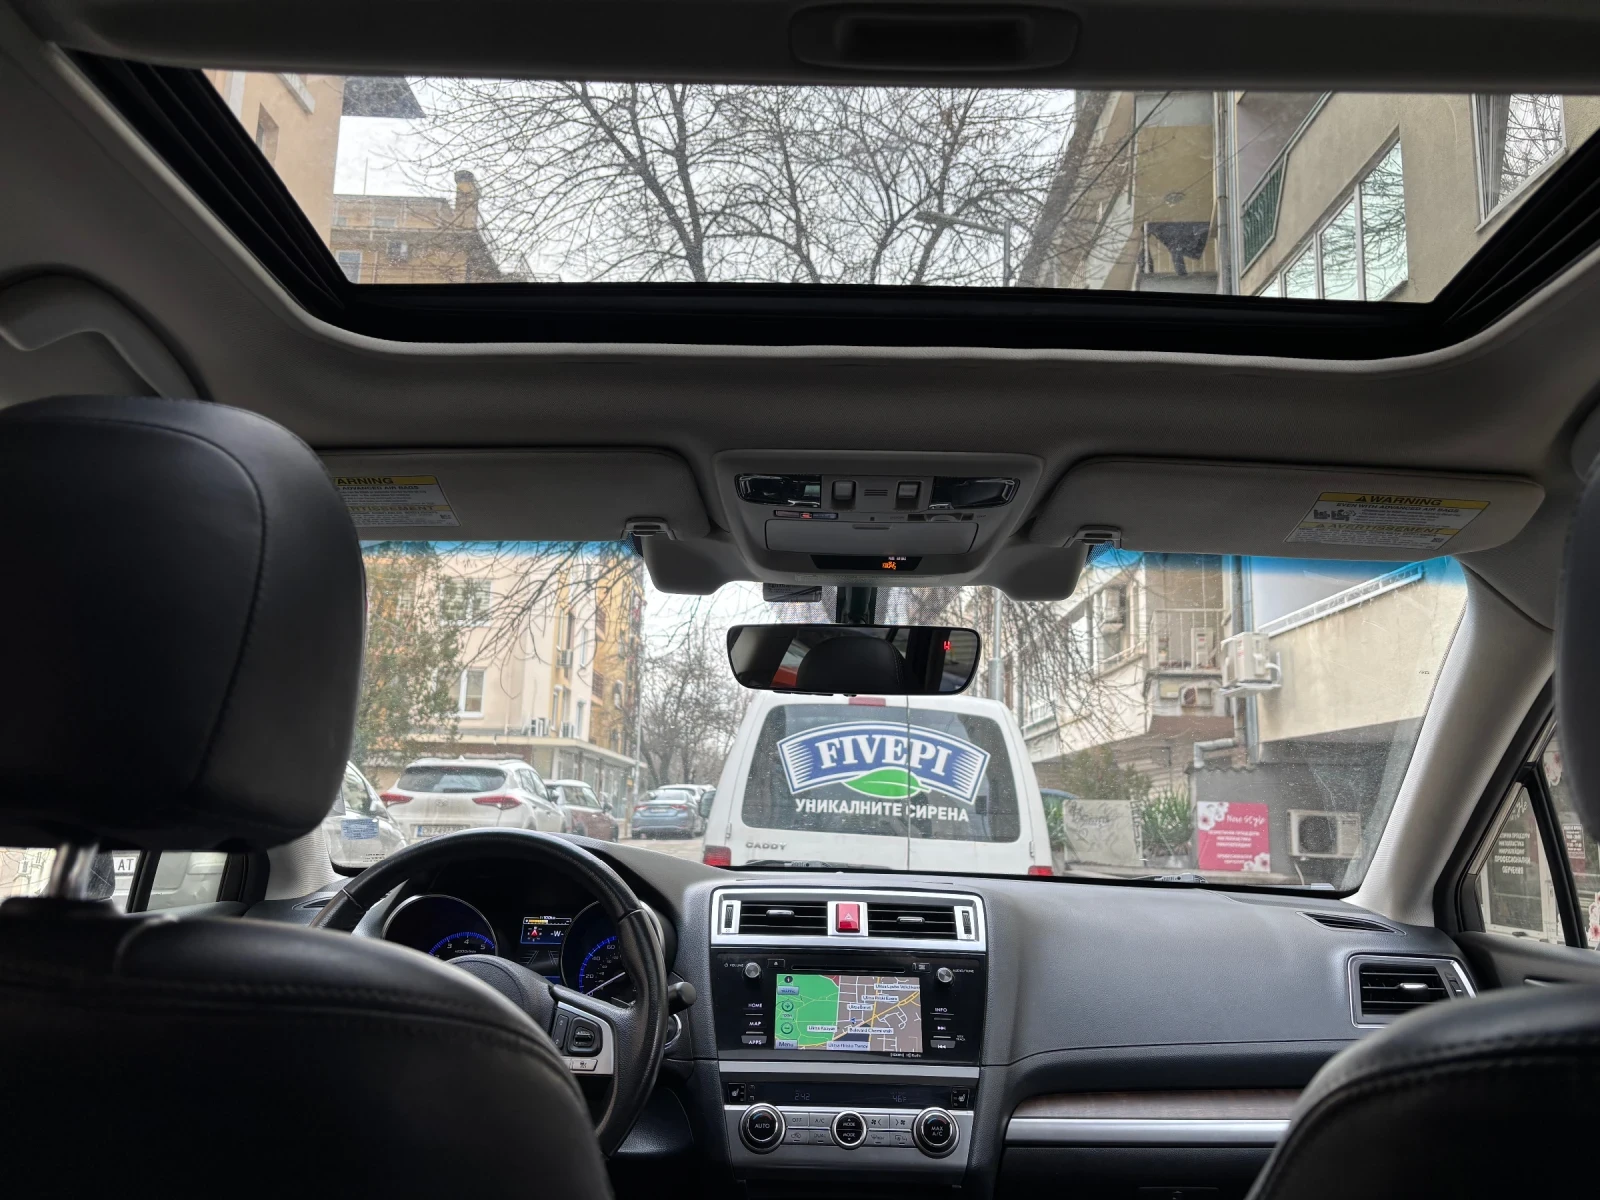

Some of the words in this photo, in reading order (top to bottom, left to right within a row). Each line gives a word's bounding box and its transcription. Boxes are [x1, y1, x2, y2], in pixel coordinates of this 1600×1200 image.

[334, 477, 394, 486] ARNING
[1369, 496, 1443, 506] WARNING
[814, 734, 953, 777] FIVEPI
[795, 798, 902, 817] УНИКАЛНИТЕ
[905, 804, 970, 823] СИРЕНА
[745, 841, 787, 851] CADDY
[117, 858, 134, 871] AT
